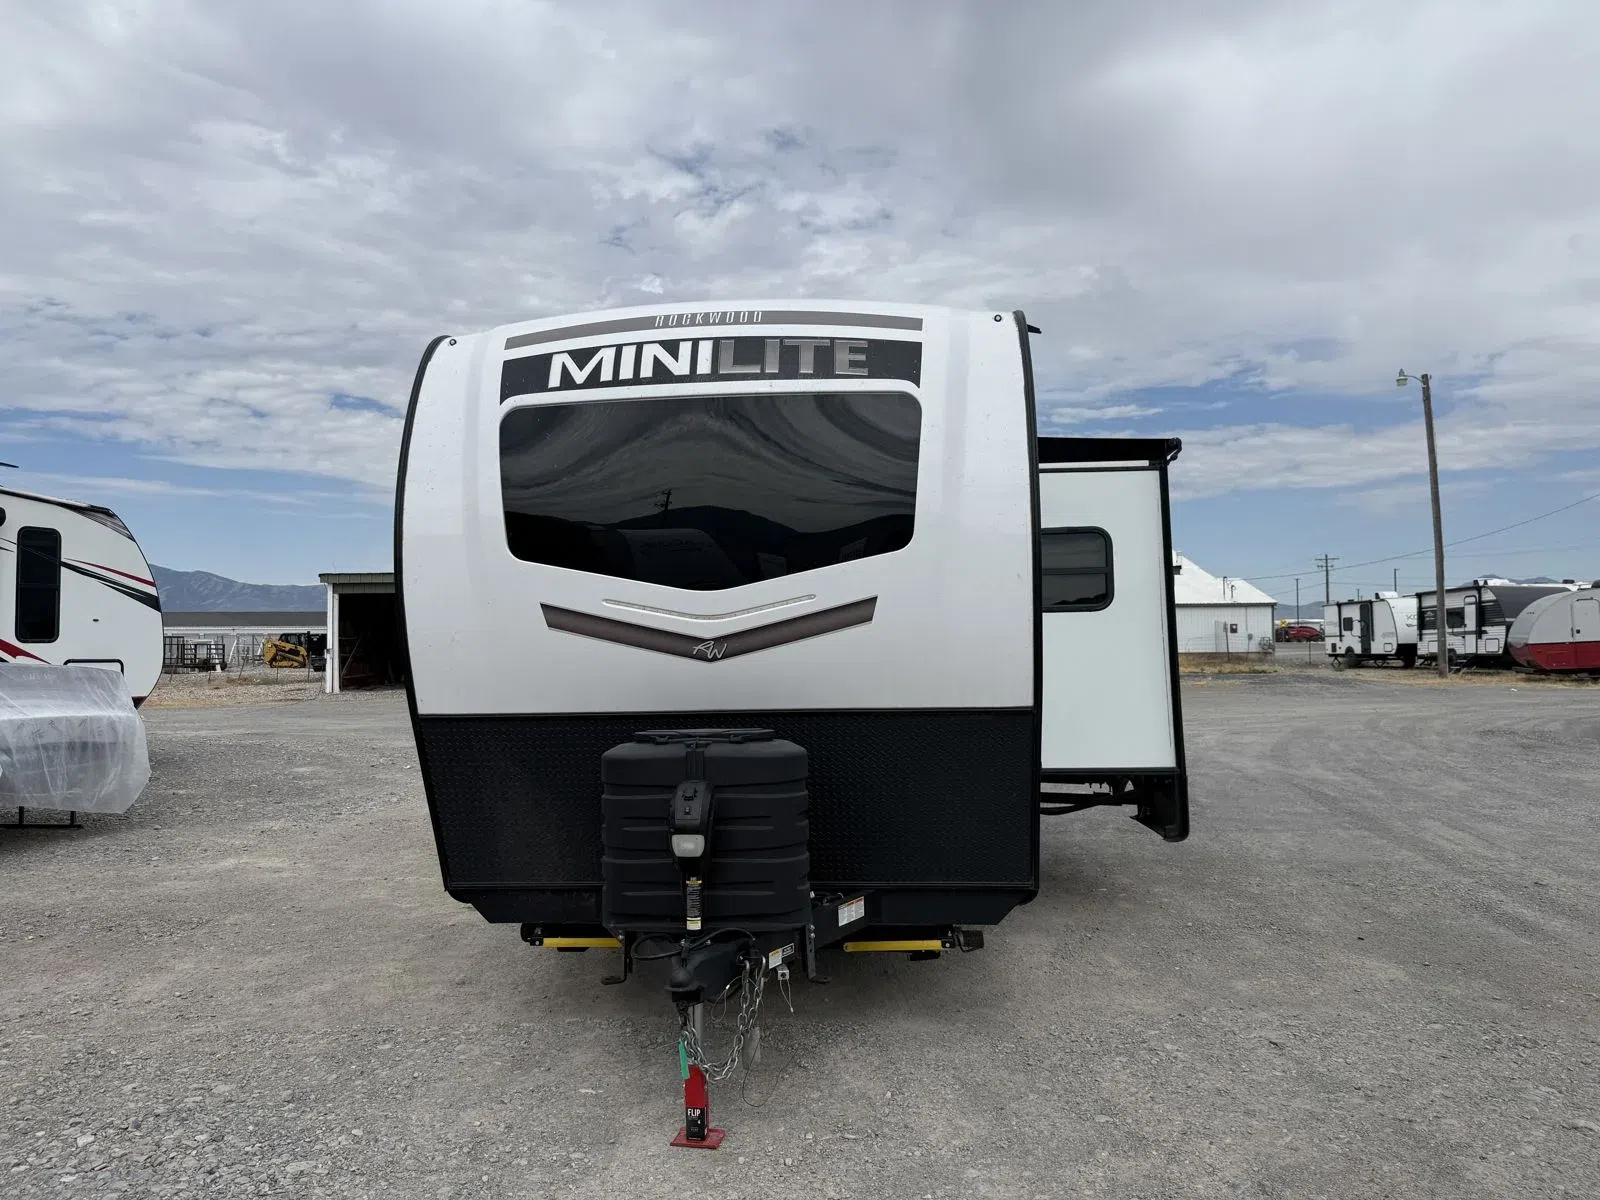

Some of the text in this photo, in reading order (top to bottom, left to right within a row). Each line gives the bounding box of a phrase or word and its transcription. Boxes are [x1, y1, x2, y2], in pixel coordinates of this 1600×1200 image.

[655, 311, 762, 327] ROCKWOOD
[693, 640, 727, 659] RW
[687, 1108, 701, 1117] FLIP
